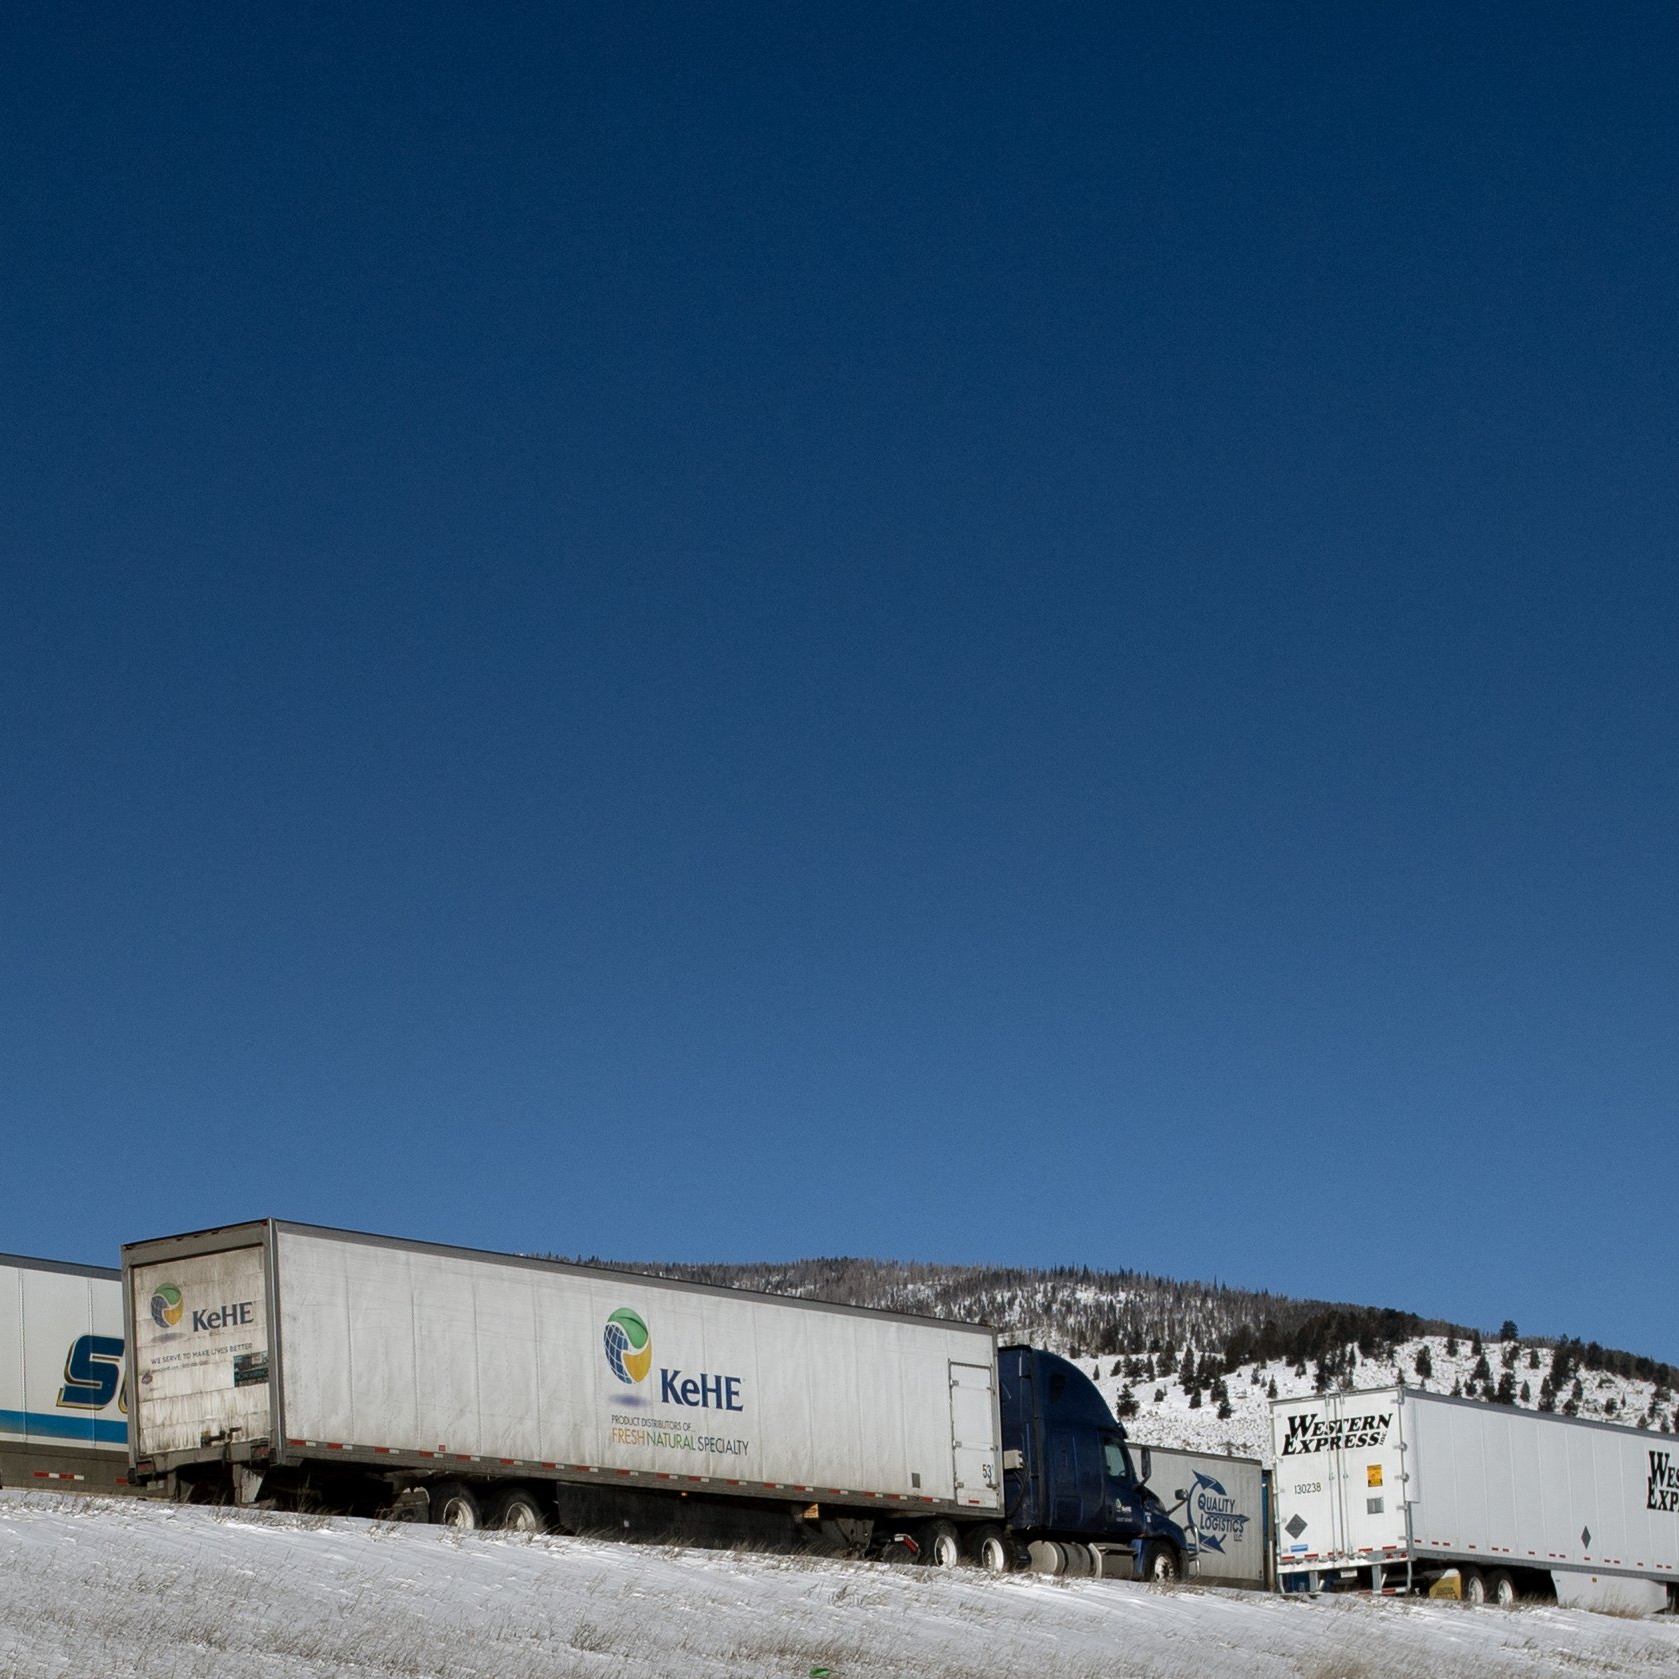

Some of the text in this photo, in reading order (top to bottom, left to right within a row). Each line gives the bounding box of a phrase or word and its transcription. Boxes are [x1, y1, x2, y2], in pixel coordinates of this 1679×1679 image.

[192, 1301, 254, 1333] KeHE
[162, 1353, 181, 1364] SERVE
[183, 1352, 191, 1360] TO
[192, 1349, 210, 1358] MAKE
[211, 1346, 229, 1355] LIVES
[229, 1343, 252, 1353] BETTER
[659, 1368, 744, 1412] KeHE
[611, 1414, 640, 1427] PRODUCT
[641, 1418, 682, 1431] DISTRIBUTORS
[1287, 1413, 1393, 1439] WESTERN
[611, 1427, 749, 1456] FRESH NATURAL SPECIALTY
[1281, 1431, 1381, 1456] EXPRESS
[1294, 1482, 1322, 1495] 130238
[1197, 1492, 1236, 1513] QUALITY
[1200, 1513, 1244, 1534] LOGISTICS
